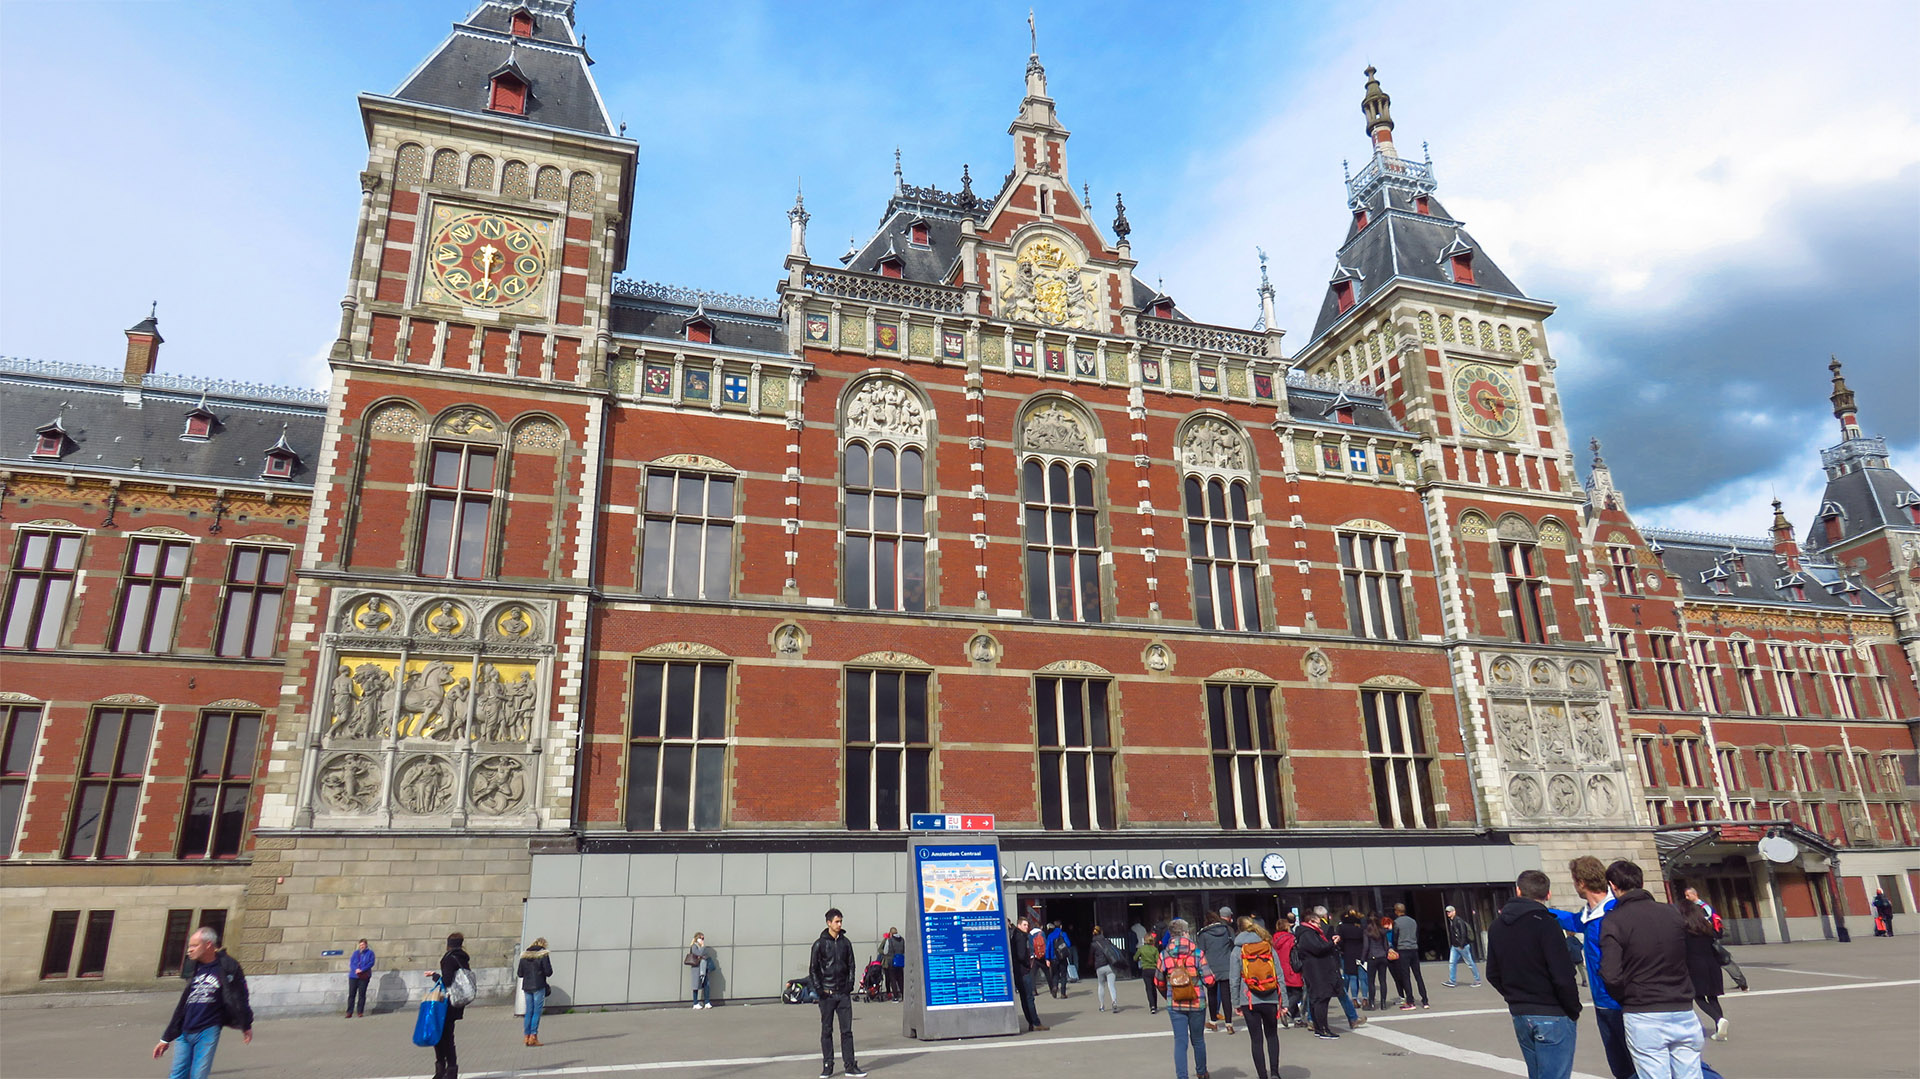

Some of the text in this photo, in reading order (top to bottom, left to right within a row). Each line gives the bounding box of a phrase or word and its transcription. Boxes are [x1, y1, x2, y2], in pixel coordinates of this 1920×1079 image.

[483, 220, 501, 236] N
[519, 258, 537, 274] O
[948, 816, 959, 825] EU
[1023, 857, 1250, 881] Amsterdam Centraal
